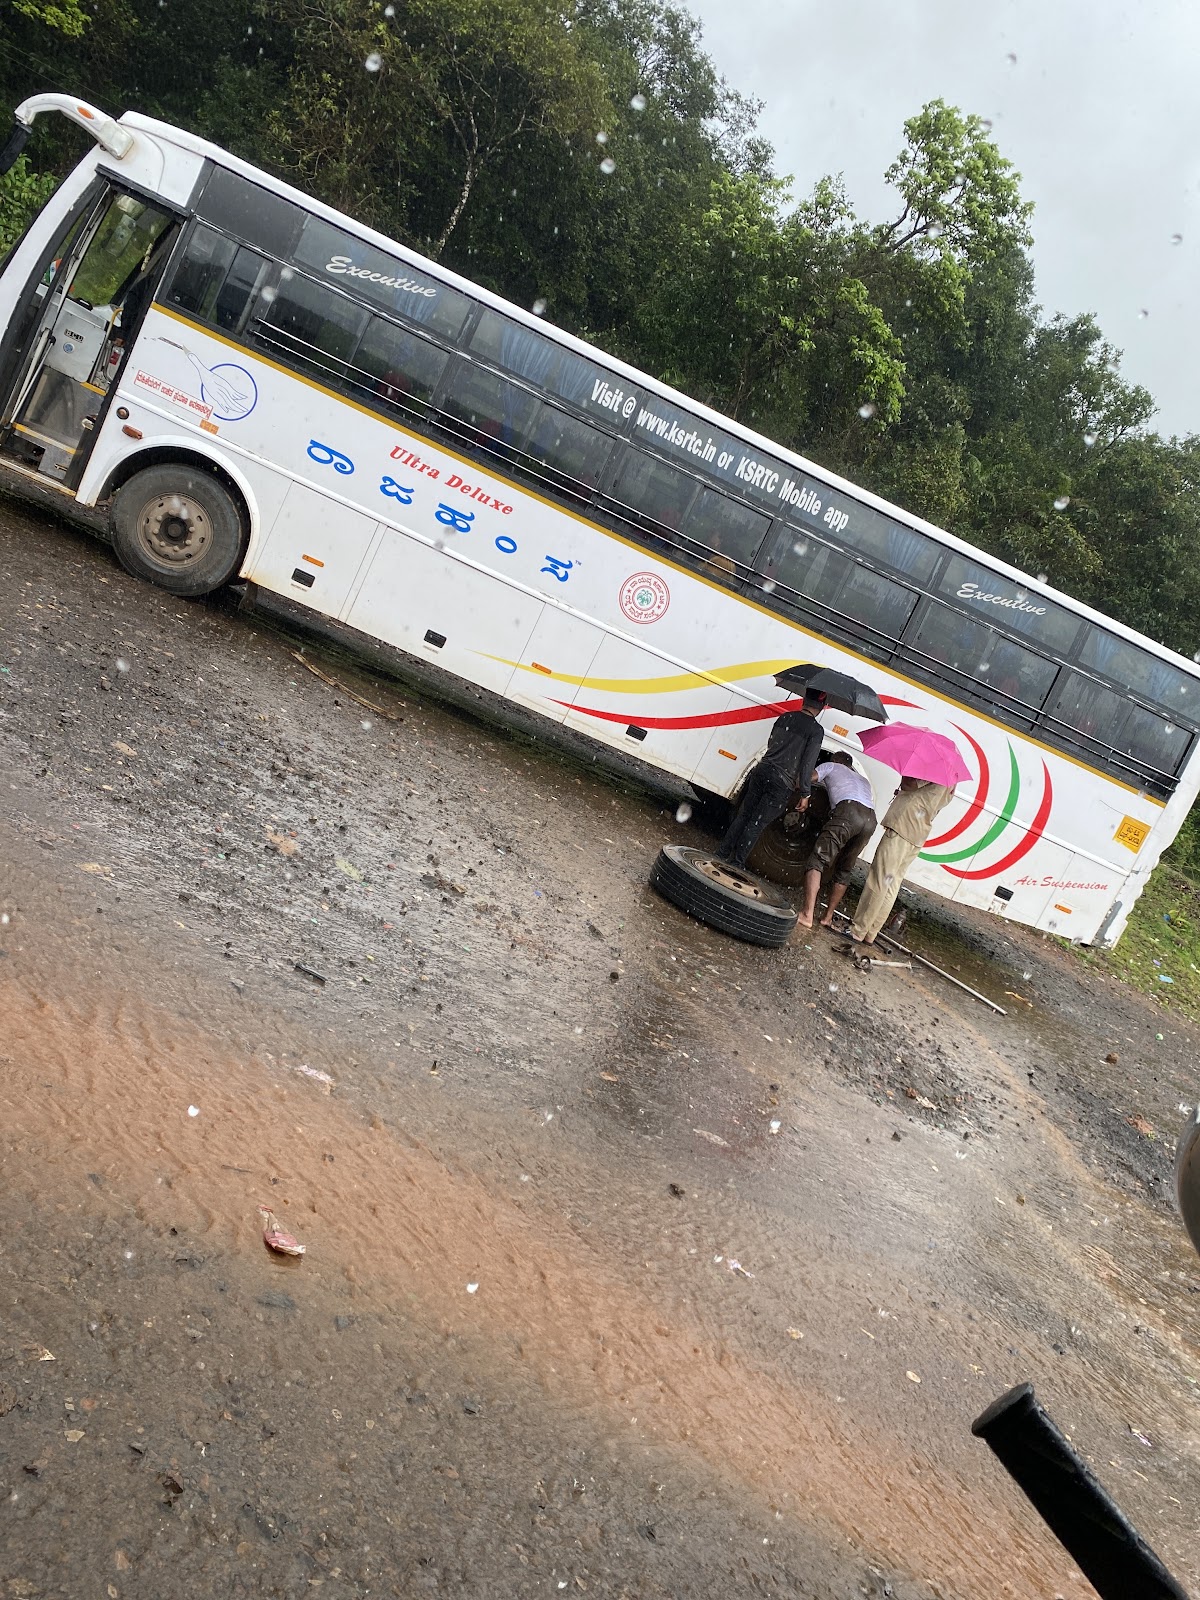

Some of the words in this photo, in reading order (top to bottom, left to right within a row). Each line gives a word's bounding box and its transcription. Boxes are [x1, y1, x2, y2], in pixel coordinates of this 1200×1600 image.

[325, 256, 437, 297] Executive
[590, 379, 624, 413] Visit
[622, 396, 637, 418] @
[637, 407, 717, 464] www.ksrtc.in
[717, 451, 735, 470] or
[735, 458, 779, 493] KSRTC
[778, 478, 822, 516] Mobile
[823, 506, 849, 532] app
[389, 445, 440, 479] Ultra
[444, 474, 514, 515] Deluxe
[956, 582, 1046, 615] Executive
[1014, 875, 1038, 886] Air
[1040, 876, 1108, 890] Suspension
